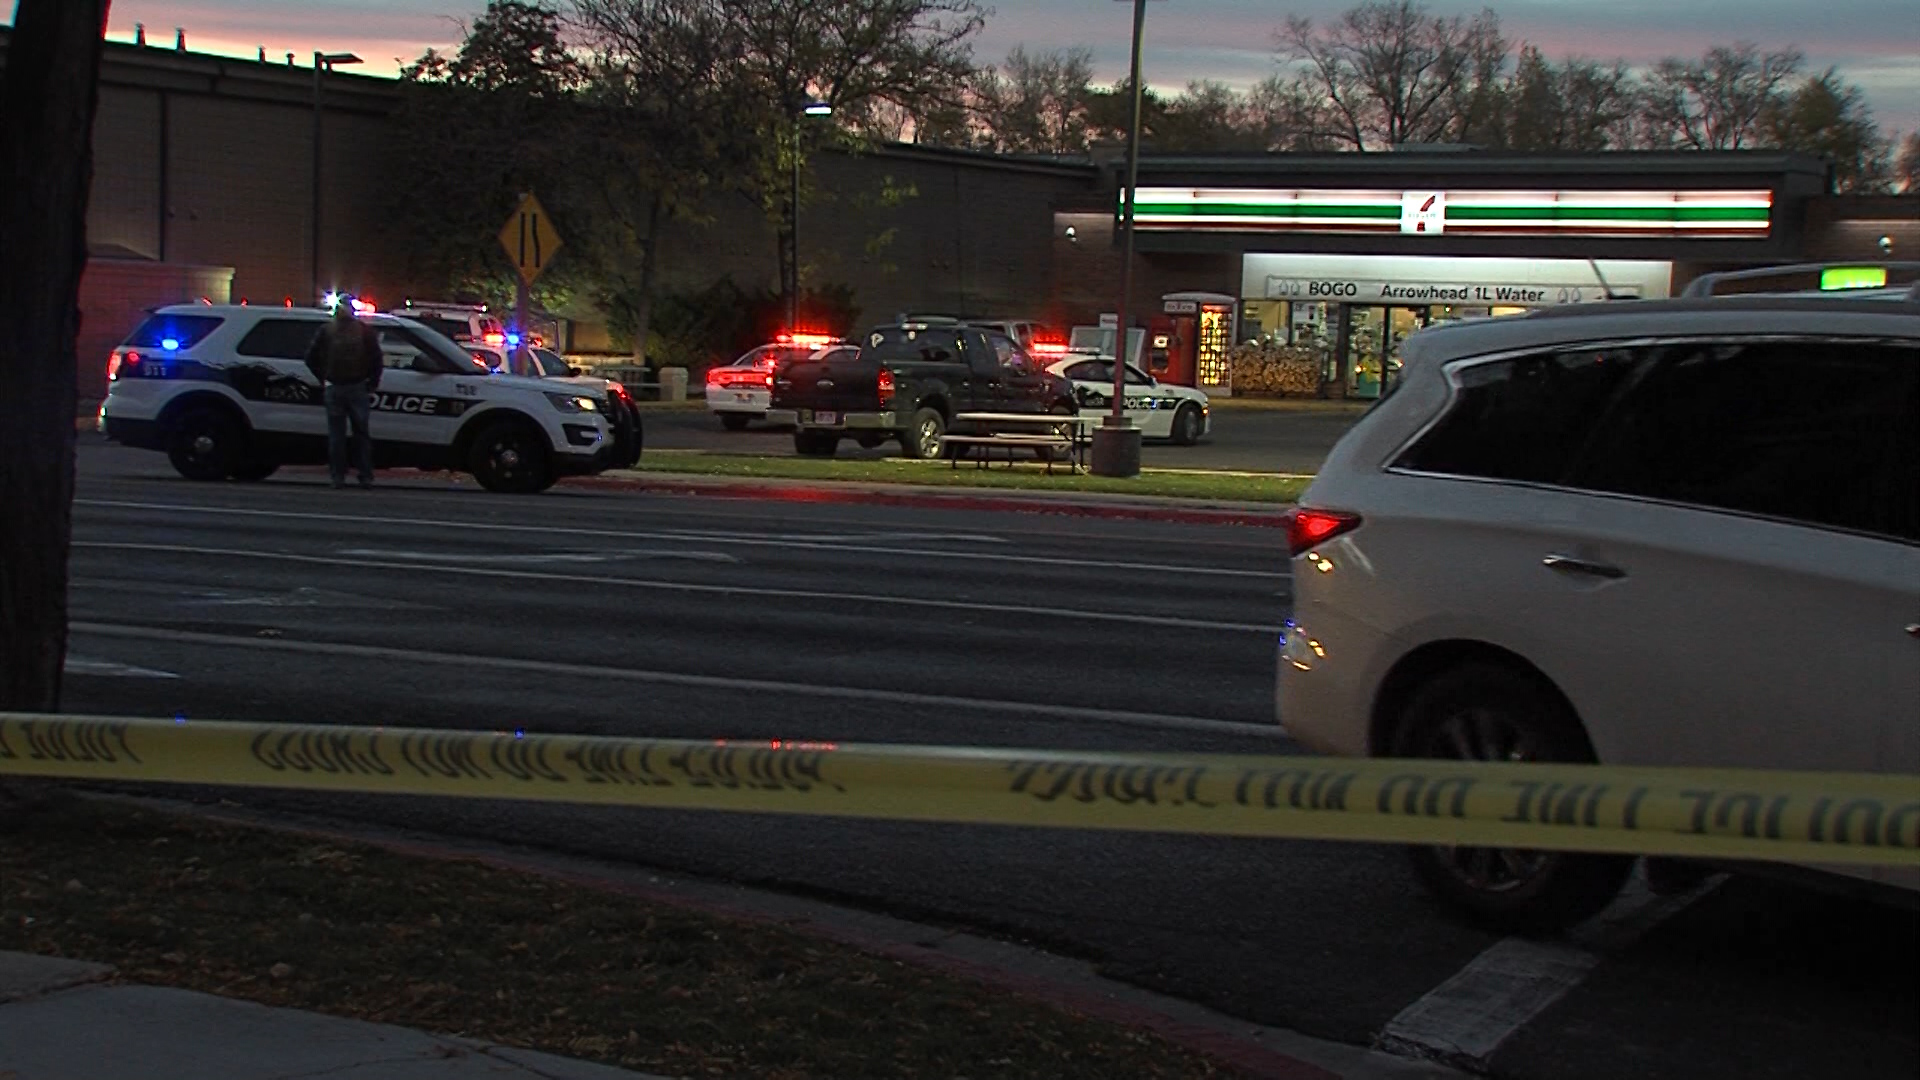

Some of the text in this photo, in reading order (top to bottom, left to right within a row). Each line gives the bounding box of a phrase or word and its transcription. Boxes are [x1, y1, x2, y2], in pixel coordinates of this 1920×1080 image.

[1308, 281, 1545, 302] BOGO Arrowhead 1L Water
[368, 393, 438, 414] OLICE
